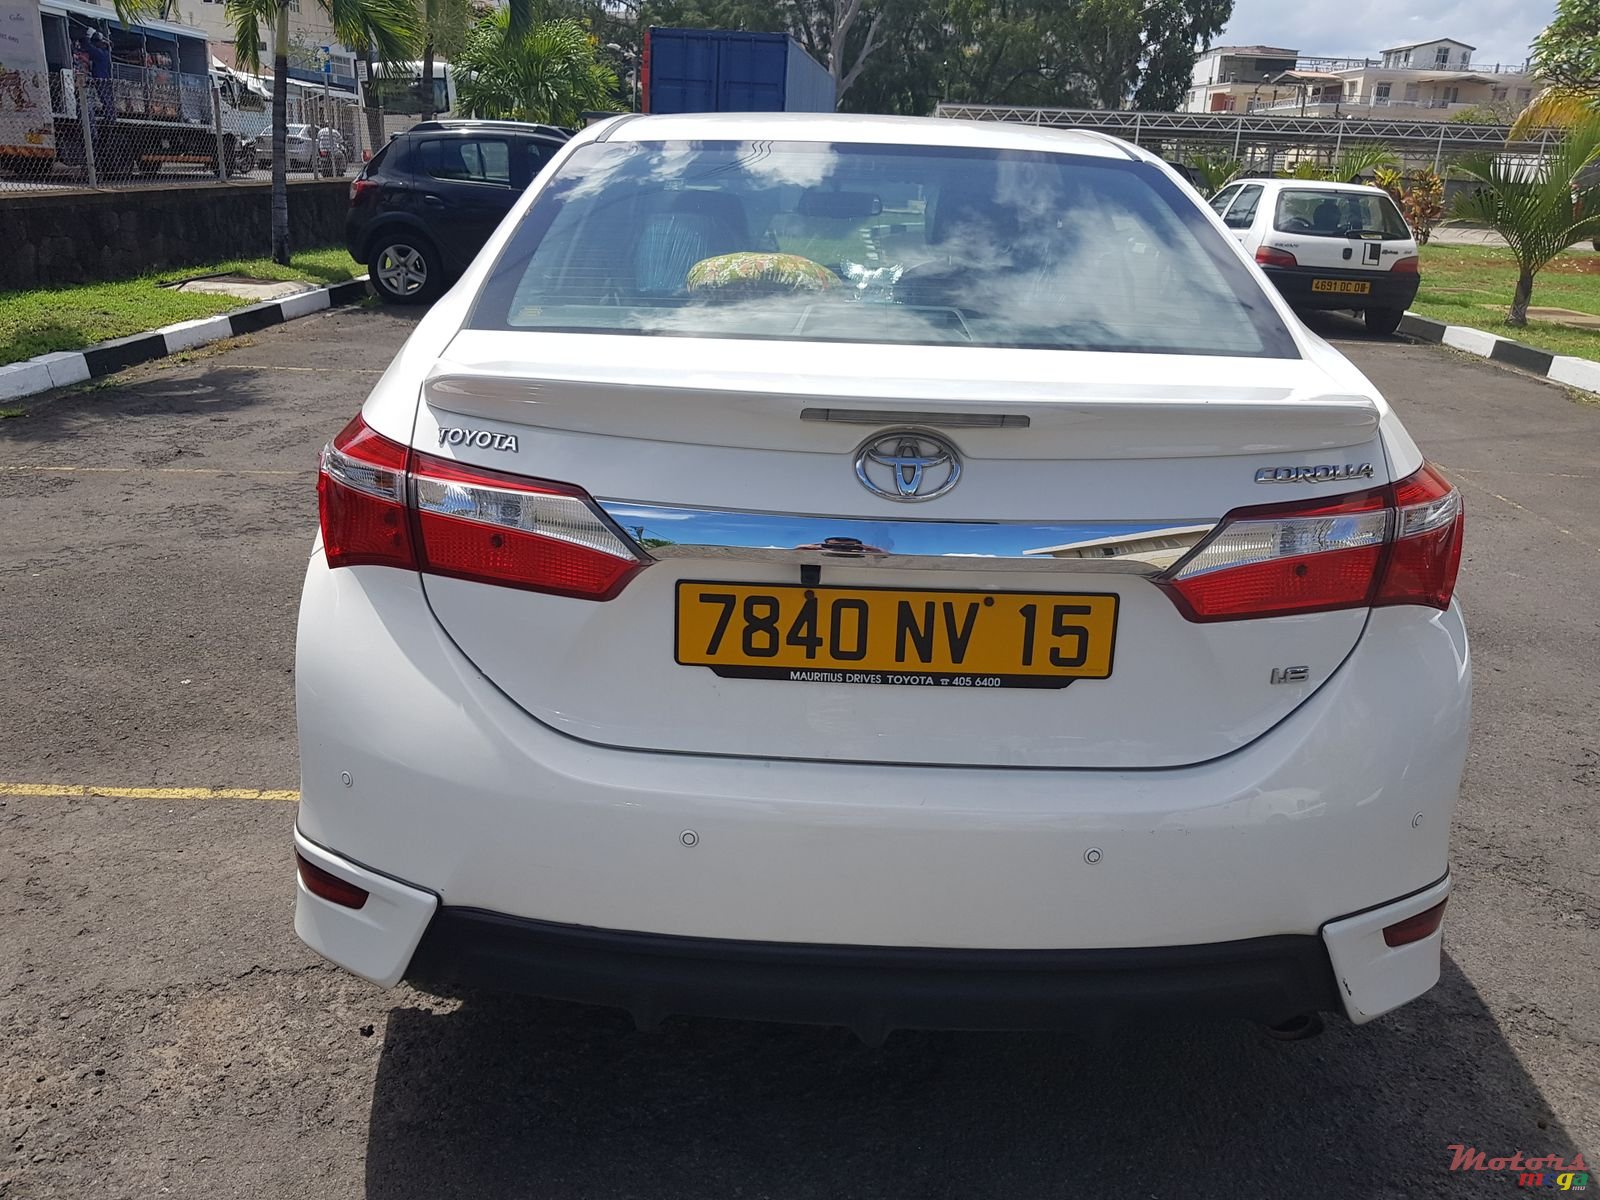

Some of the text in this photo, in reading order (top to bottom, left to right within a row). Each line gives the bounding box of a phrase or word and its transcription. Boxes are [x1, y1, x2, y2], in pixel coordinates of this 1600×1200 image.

[1314, 280, 1338, 291] 4691
[438, 427, 519, 453] TOYOTA
[1255, 462, 1375, 484] COROLLA
[699, 593, 1091, 667] 7840 NV 15
[790, 671, 1001, 687] MAURITIUS DRIVES TOYOTA 405 6400
